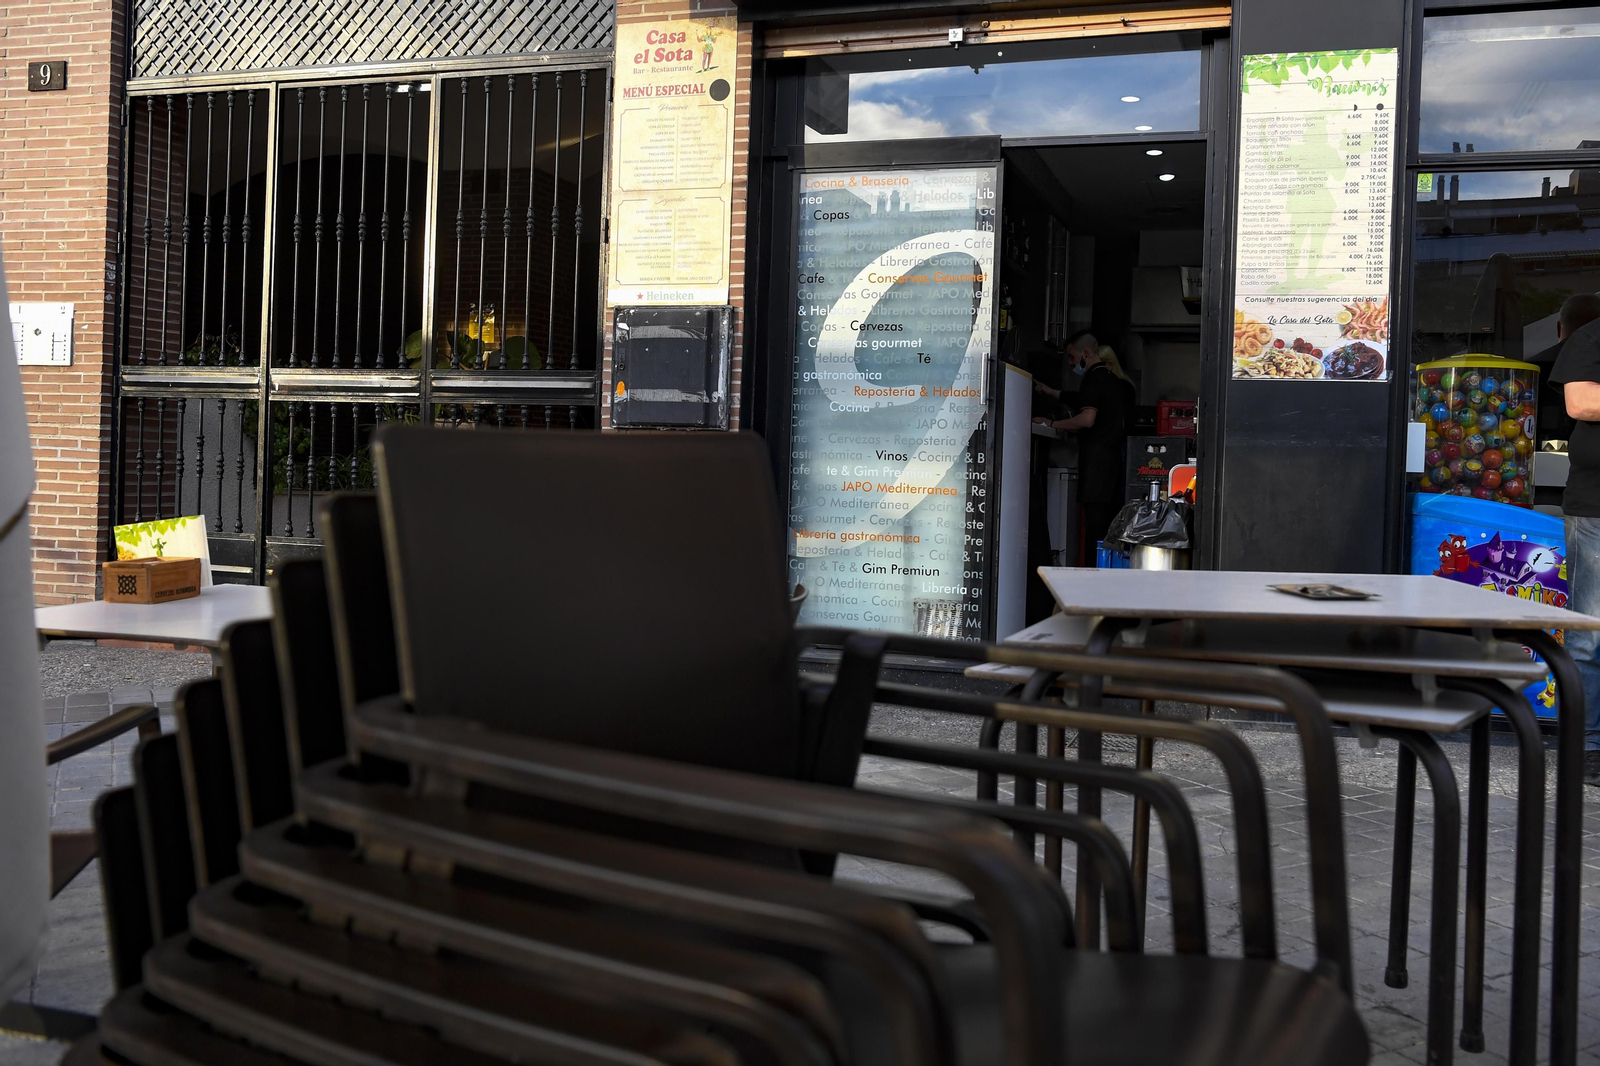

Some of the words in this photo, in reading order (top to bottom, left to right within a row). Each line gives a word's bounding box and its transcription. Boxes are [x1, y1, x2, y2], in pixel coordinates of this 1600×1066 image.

[646, 30, 686, 45] Casa
[634, 49, 650, 64] el
[654, 48, 693, 62] Sota
[40, 64, 51, 86] 9
[652, 65, 694, 73] Restaurante
[623, 84, 652, 98] MENÚ
[656, 83, 706, 96] ESPECIAL
[805, 177, 845, 188] Cocina
[848, 176, 857, 187] &
[862, 176, 909, 186] Brasería
[982, 172, 990, 182] &
[814, 209, 850, 222] Copas
[964, 237, 992, 248] Café
[880, 256, 924, 266] Librería
[798, 272, 825, 284] Cafe
[868, 272, 930, 284] Conservas
[934, 271, 988, 283] Gourmet
[646, 292, 694, 300] Heineken
[861, 288, 913, 299] Gourmet
[798, 306, 806, 316] &
[850, 320, 903, 331] Cervezas
[1267, 316, 1276, 325] La
[1280, 316, 1297, 324] Casa
[1314, 315, 1333, 325] Sota
[871, 338, 922, 351] gourmet
[917, 352, 931, 363] Té
[803, 369, 882, 382] gastronómica
[854, 385, 915, 399] Repostería
[920, 386, 928, 396] &
[933, 386, 981, 397] Helados
[830, 400, 870, 412] Cocina
[916, 418, 948, 430] JAPO
[828, 433, 880, 444] Cervezas
[894, 434, 956, 447] Repostería
[875, 450, 908, 461] Vinos
[964, 453, 973, 463] &
[827, 466, 837, 475] te
[841, 466, 850, 476] &
[854, 466, 878, 477] Gim
[1136, 466, 1169, 475] Alhambr
[841, 481, 873, 492] JAPO
[876, 483, 958, 496] Mediterranea
[971, 486, 986, 496] Re
[830, 498, 909, 509] Mediterránea
[966, 502, 974, 512] &
[793, 528, 836, 540] Librería
[840, 532, 920, 543] gastronómica
[854, 546, 862, 556] &
[962, 551, 970, 562] &
[820, 561, 828, 571] &
[832, 561, 845, 572] Té
[849, 562, 858, 572] &
[862, 562, 887, 574] Gim
[891, 564, 940, 576] Premiun
[922, 582, 968, 595] Librería
